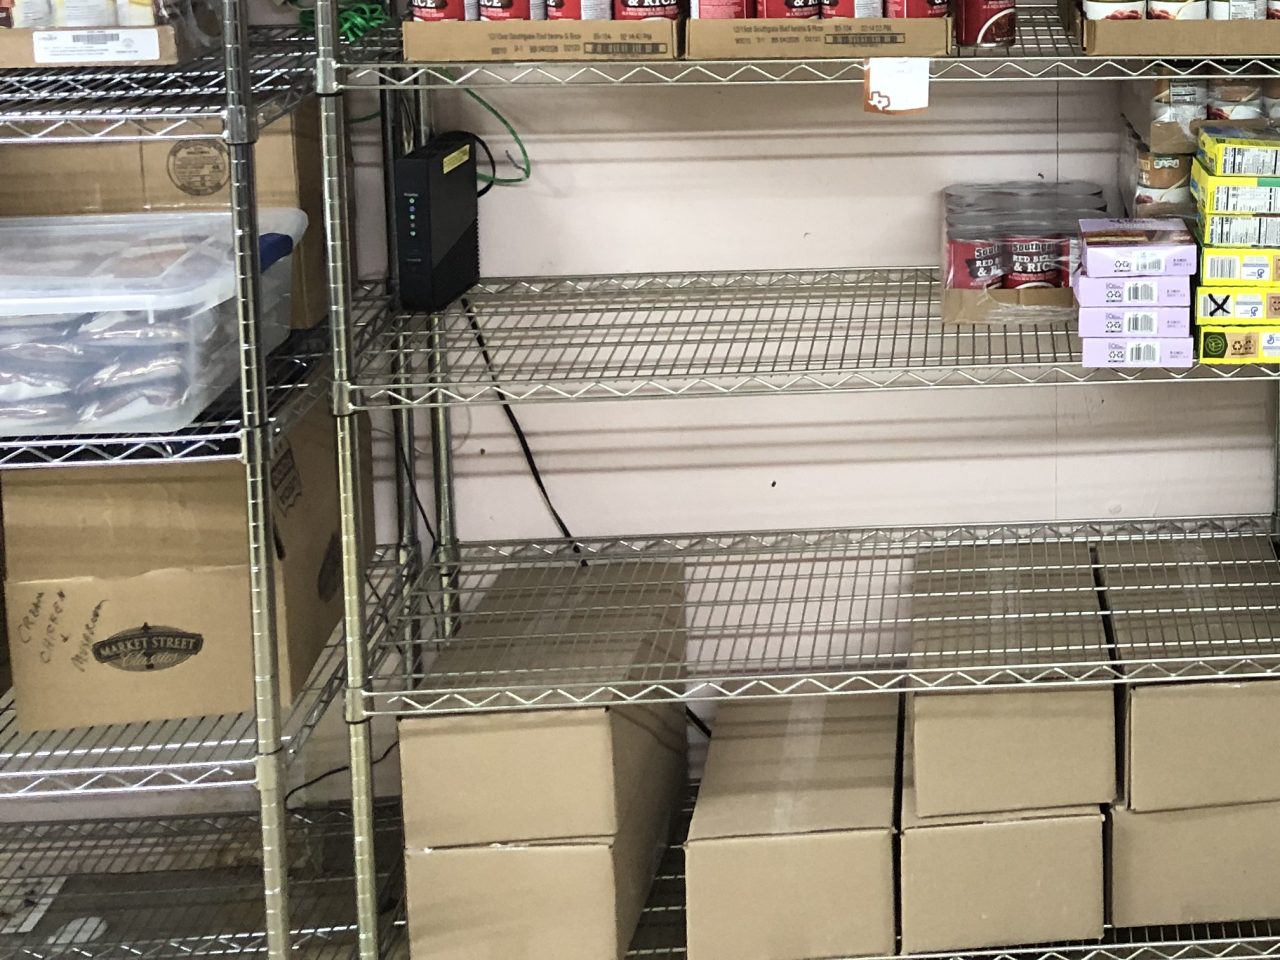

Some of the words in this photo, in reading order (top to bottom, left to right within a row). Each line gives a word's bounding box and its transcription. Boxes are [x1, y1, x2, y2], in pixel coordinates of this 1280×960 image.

[1028, 262, 1050, 272] RIC
[100, 637, 148, 657] MARKET
[151, 636, 196, 650] STREET
